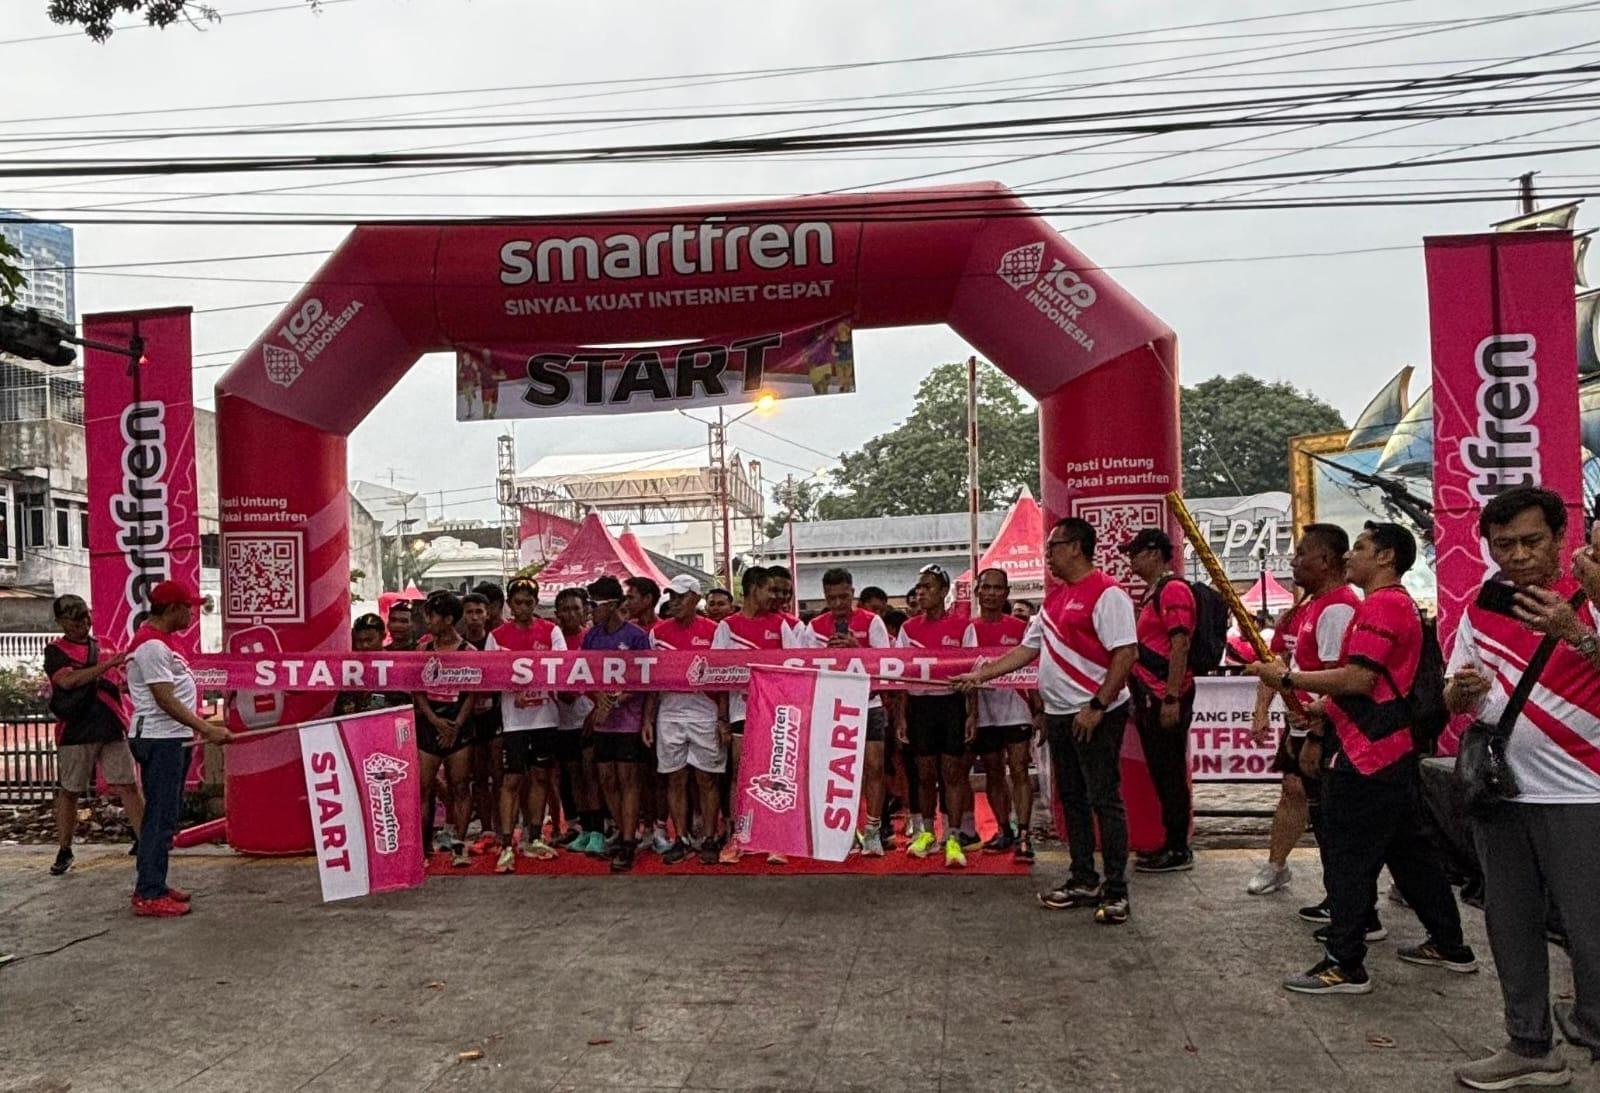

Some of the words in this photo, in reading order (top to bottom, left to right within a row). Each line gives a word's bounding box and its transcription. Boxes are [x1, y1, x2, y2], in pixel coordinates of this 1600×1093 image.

[500, 216, 833, 284] smartfren
[504, 298, 582, 317] SINYAL
[586, 292, 644, 312] KUAT
[649, 284, 759, 308] INTERNET
[762, 280, 835, 301] CEPAT
[1036, 279, 1082, 321] UNTUK
[295, 311, 335, 352] UNTUK
[304, 300, 364, 362] INDONESIA
[1025, 289, 1095, 353] INDONESIA
[524, 331, 783, 408] START
[1066, 458, 1099, 473] Pasti
[1102, 457, 1155, 470] Untung
[1067, 474, 1103, 489] Pakai
[1106, 472, 1170, 485] smartfren
[240, 497, 288, 509] Untung
[244, 511, 307, 522] smartfren
[193, 669, 227, 677] martfren
[255, 660, 394, 687] START
[511, 657, 657, 684] START
[772, 707, 787, 775] smartfren
[785, 724, 799, 767] RUN
[824, 698, 861, 832] START
[311, 752, 351, 873] START
[371, 799, 386, 839] RUN
[381, 785, 398, 851] smartfren
